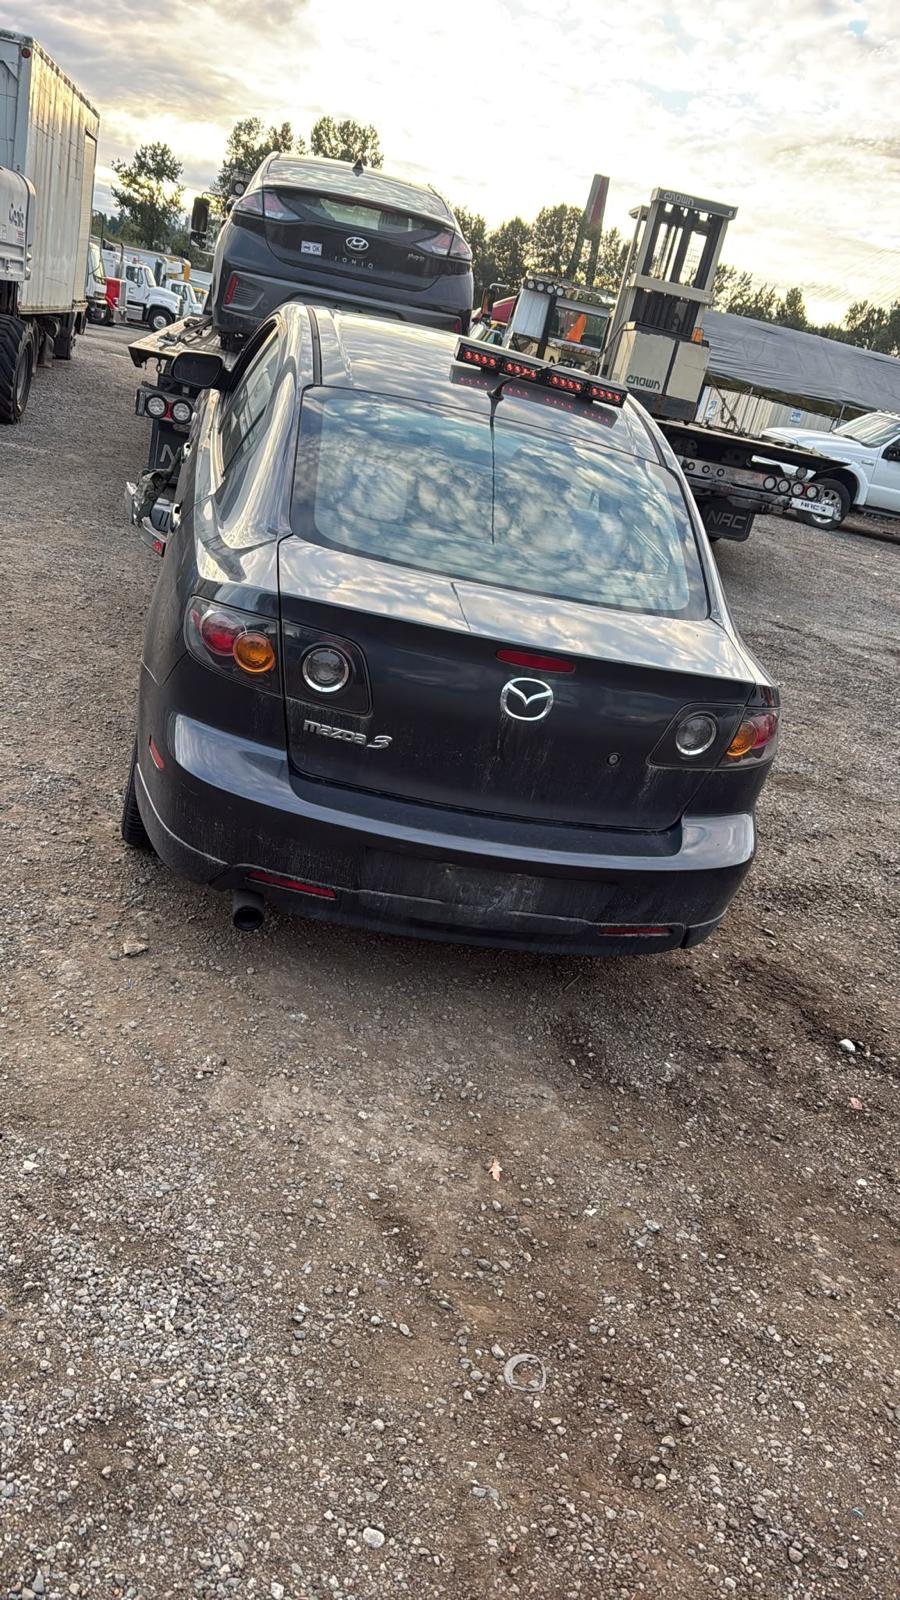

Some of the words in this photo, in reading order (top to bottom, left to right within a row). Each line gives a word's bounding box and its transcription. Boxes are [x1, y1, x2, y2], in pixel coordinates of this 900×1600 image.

[334, 256, 374, 269] IONIQ
[303, 719, 366, 746] mazda
[366, 735, 393, 750] 3
